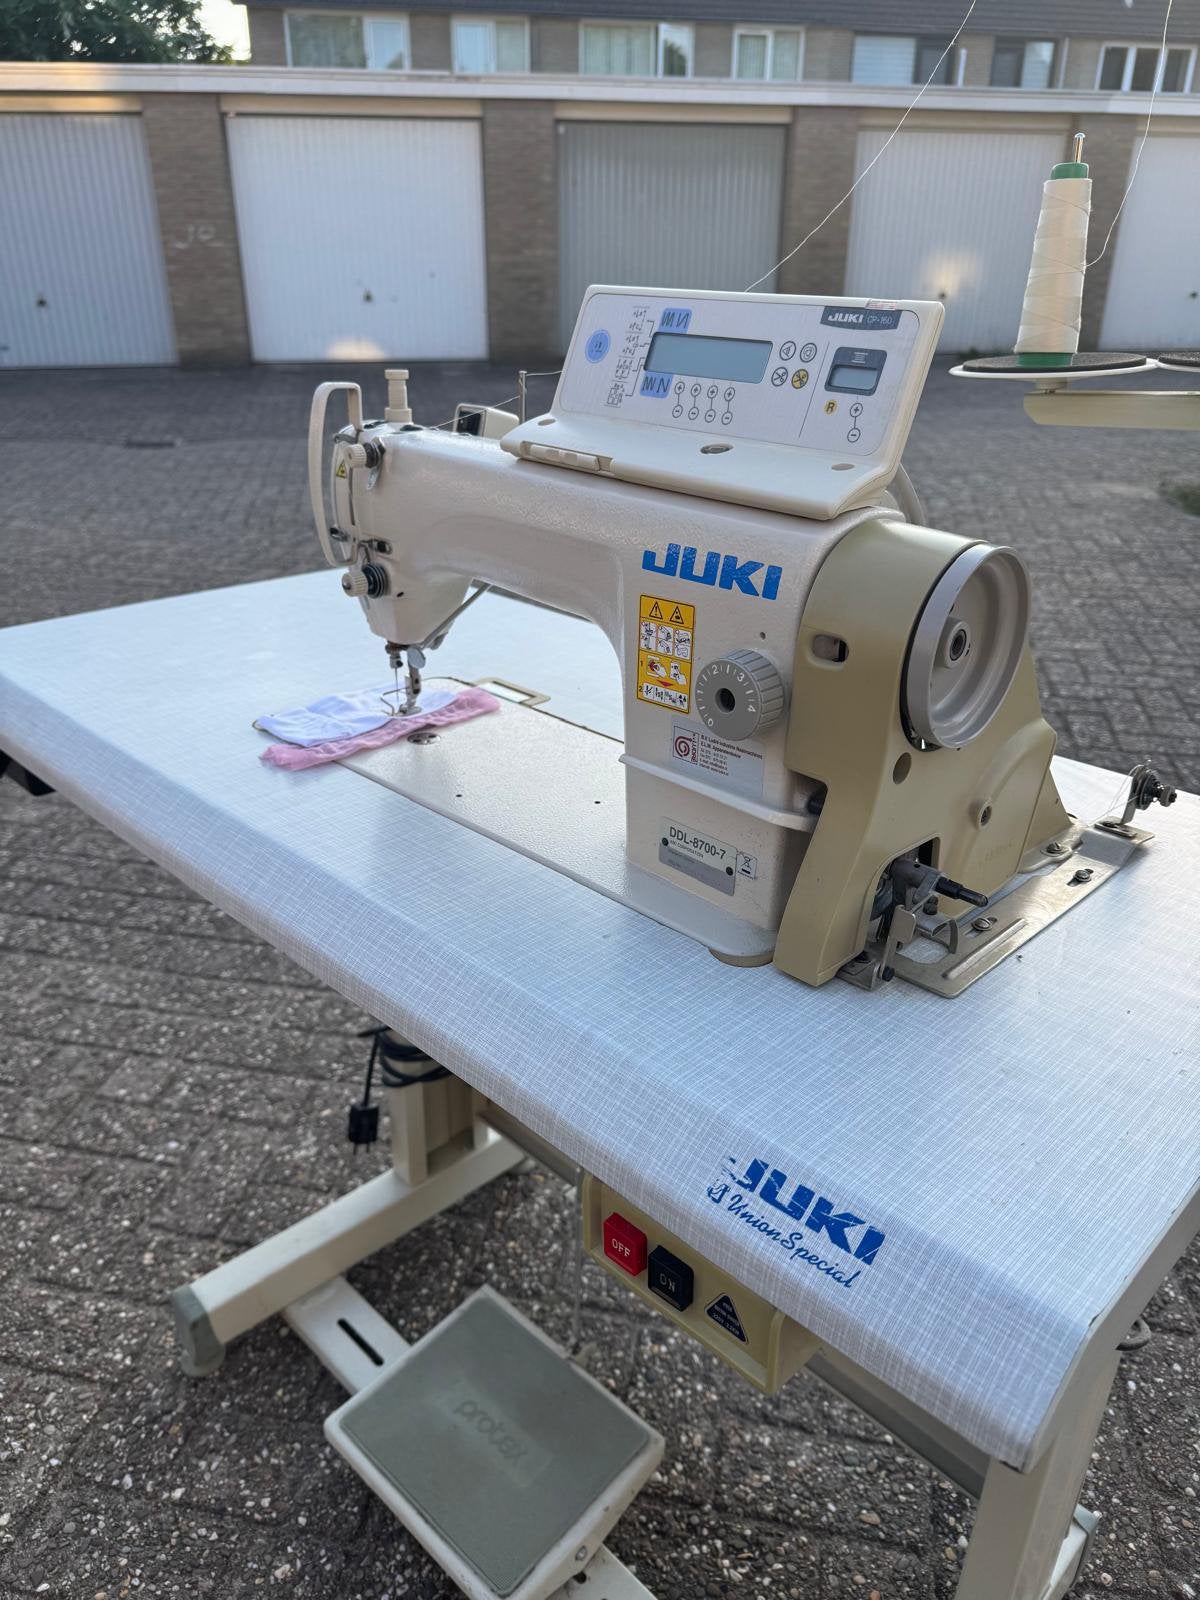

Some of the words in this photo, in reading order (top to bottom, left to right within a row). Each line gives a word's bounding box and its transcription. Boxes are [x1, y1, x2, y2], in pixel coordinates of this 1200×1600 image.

[828, 312, 864, 324] JUKI
[826, 402, 835, 414] R
[641, 543, 783, 600] JUKI
[711, 664, 719, 675] 2
[736, 672, 745, 682] 3
[707, 718, 714, 727] 0
[670, 826, 726, 859] DDL-8700-7
[721, 1156, 886, 1266] JUKI
[611, 1238, 631, 1257] OFF
[660, 1273, 676, 1293] ON
[453, 1400, 528, 1467] protex
